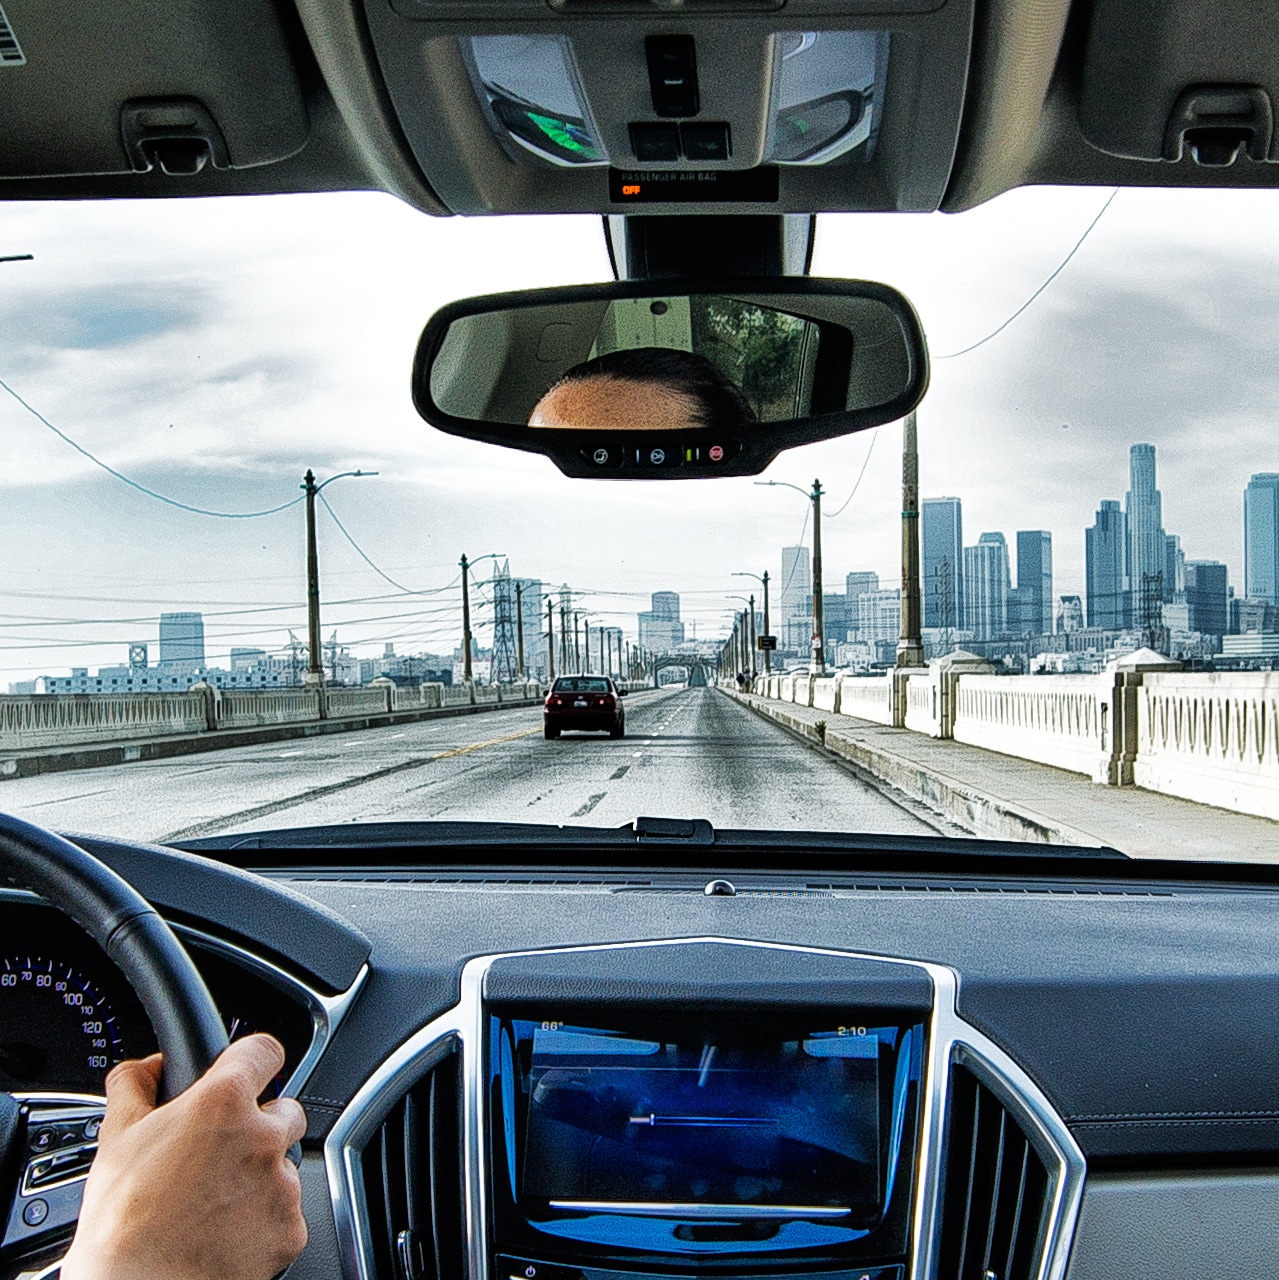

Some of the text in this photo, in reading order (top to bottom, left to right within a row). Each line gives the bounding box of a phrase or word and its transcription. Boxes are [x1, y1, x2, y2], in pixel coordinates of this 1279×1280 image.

[622, 173, 717, 181] PASSENGER AIR BAG
[622, 185, 641, 195] OFF
[1, 974, 17, 986] 60
[21, 971, 32, 981] 70
[36, 974, 52, 987] 80
[55, 981, 67, 991] 90
[63, 993, 83, 1006] 100
[81, 1005, 93, 1015] 110
[82, 1021, 102, 1034] 120
[837, 1026, 867, 1037] 2:10
[92, 1037, 107, 1048] 140
[87, 1055, 107, 1068] 160
